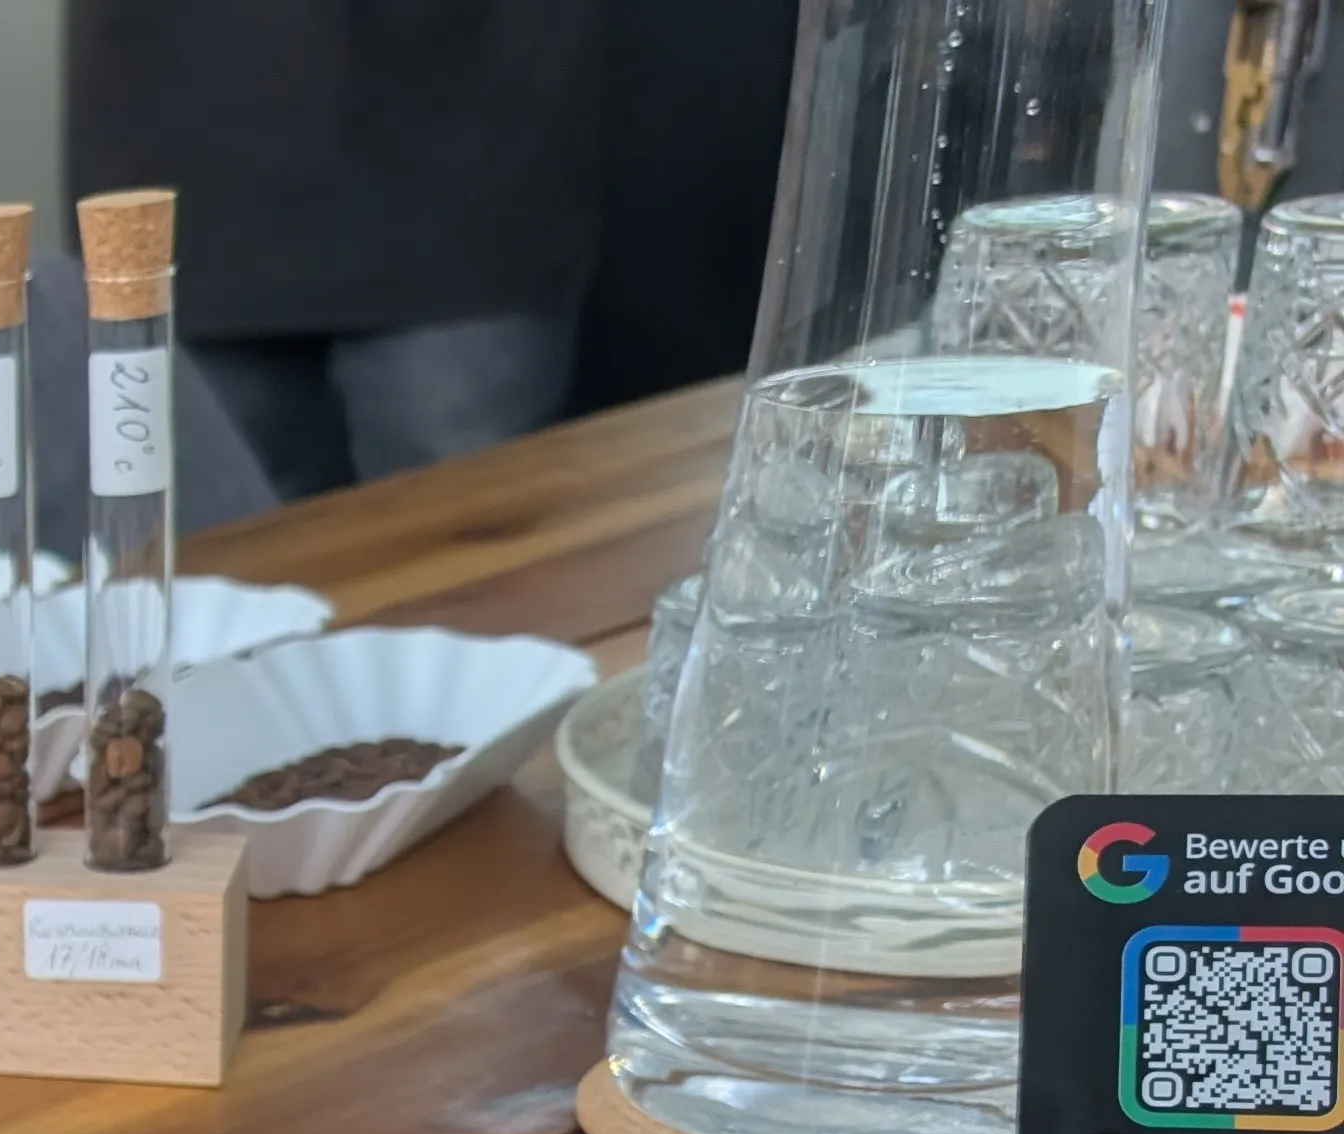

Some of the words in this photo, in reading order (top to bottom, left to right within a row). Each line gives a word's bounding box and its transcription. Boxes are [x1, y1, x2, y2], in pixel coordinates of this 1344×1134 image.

[1077, 821, 1171, 904] G
[1185, 833, 1330, 860] Bewerte
[1183, 862, 1255, 894] auf
[1263, 864, 1344, 895] Goo
